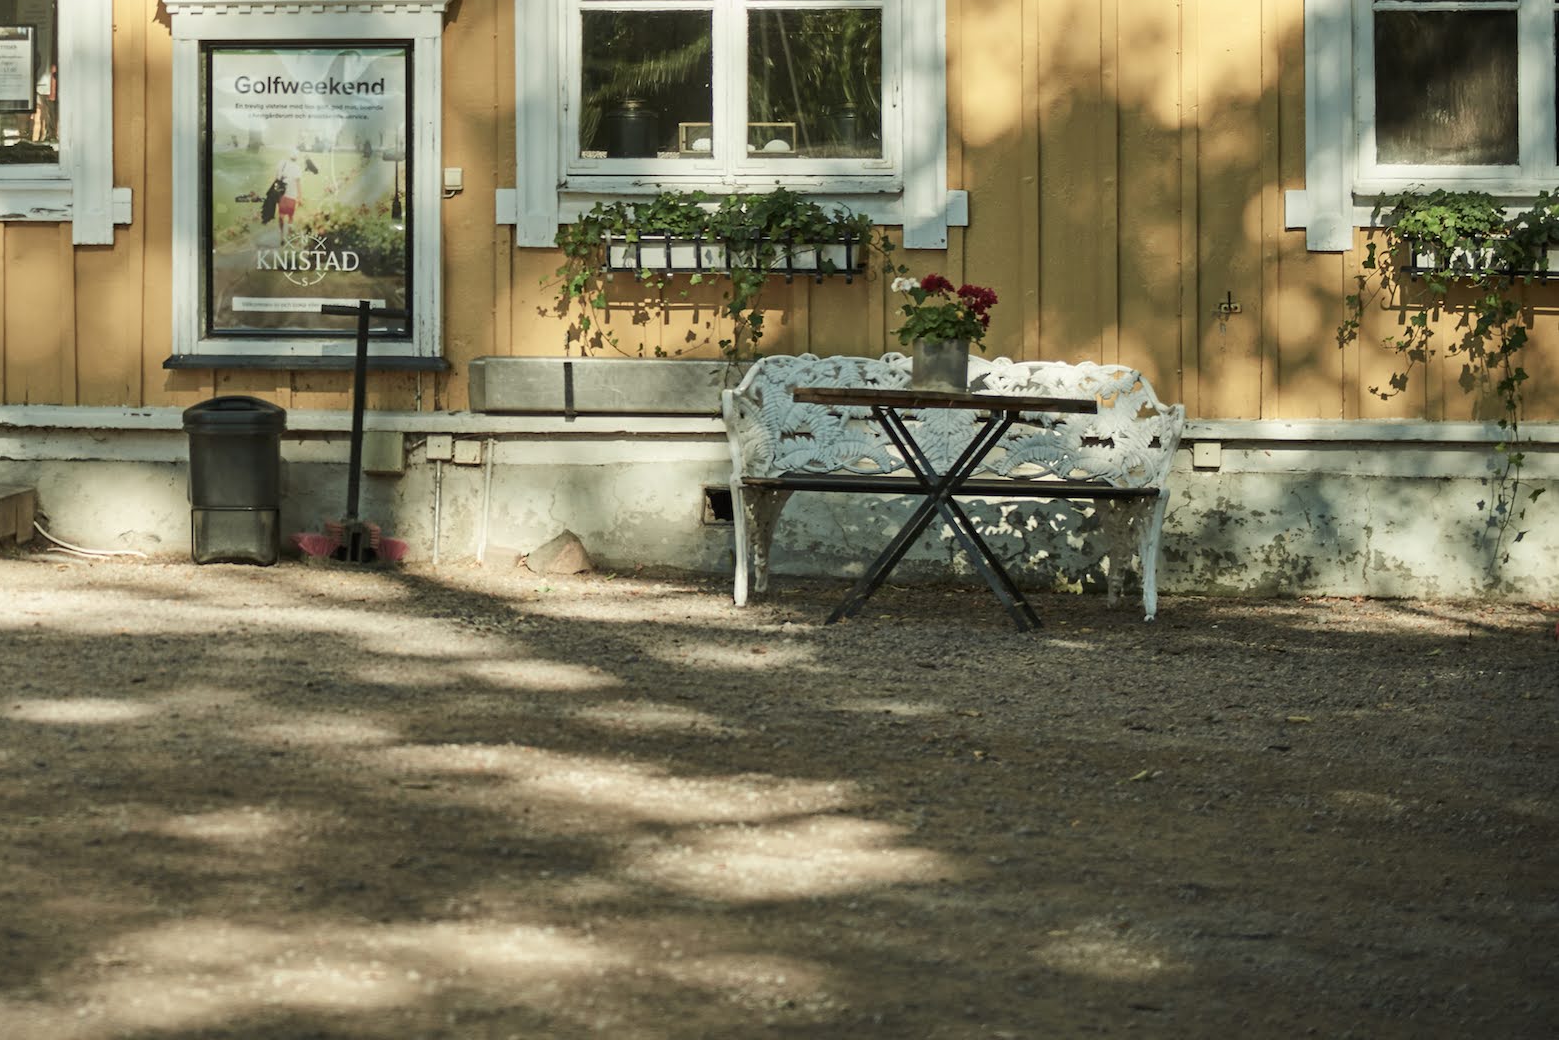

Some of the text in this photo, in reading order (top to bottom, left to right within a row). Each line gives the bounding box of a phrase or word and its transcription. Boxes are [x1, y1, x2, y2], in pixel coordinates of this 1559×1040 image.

[234, 75, 385, 96] Golfweekend
[256, 250, 360, 271] KNISTAD
[301, 277, 309, 287] S
